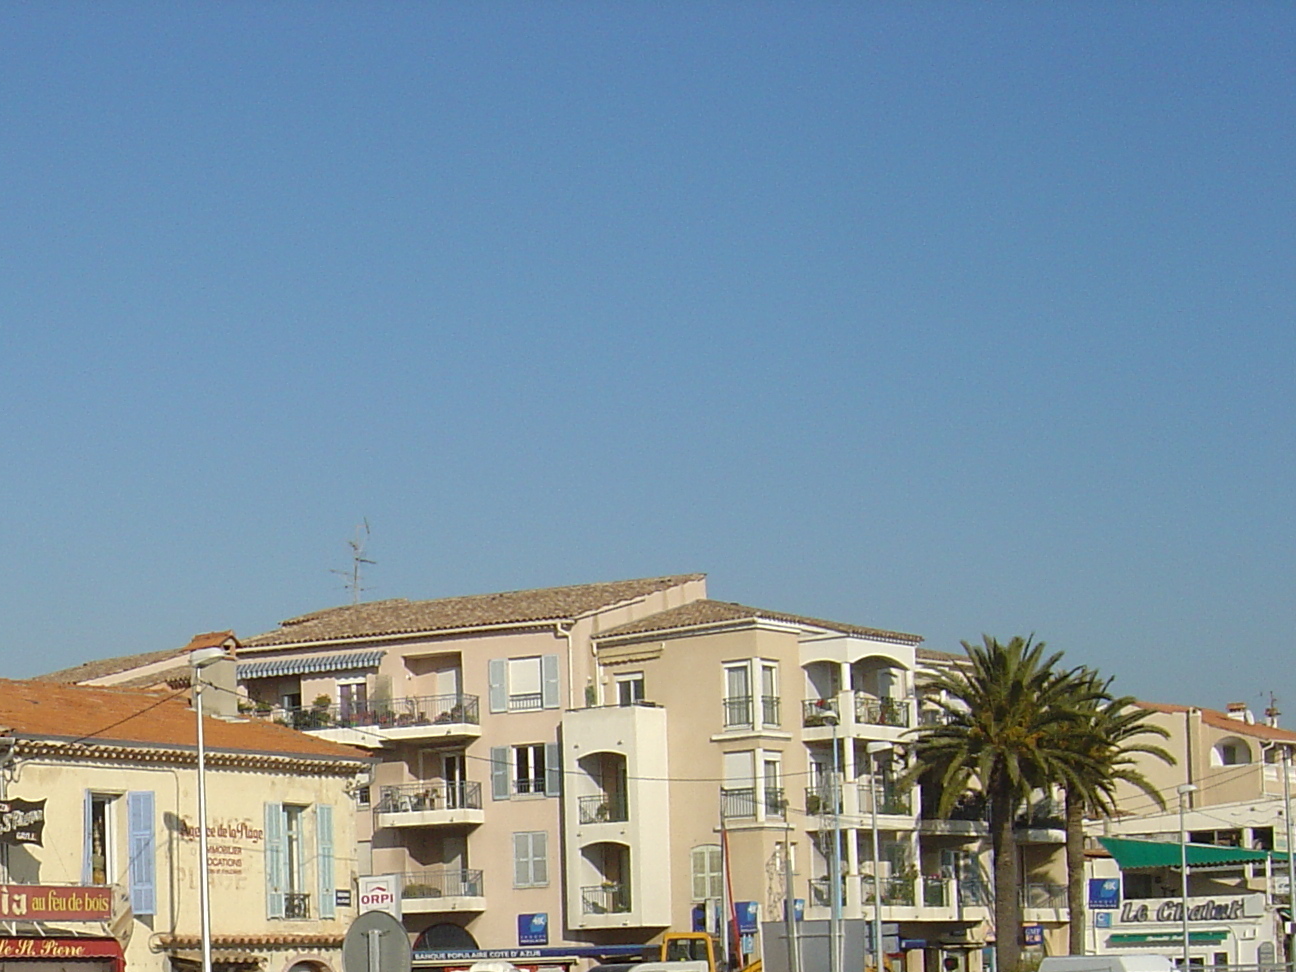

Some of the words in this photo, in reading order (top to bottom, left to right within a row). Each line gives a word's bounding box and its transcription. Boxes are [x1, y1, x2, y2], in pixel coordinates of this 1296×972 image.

[218, 824, 228, 838] de
[32, 896, 45, 911] au
[48, 889, 67, 912] feu
[68, 892, 84, 912] de
[85, 893, 109, 912] bois
[361, 893, 394, 905] ORPI
[1120, 901, 1149, 922] Le
[40, 940, 86, 956] Pierre
[415, 952, 445, 960] BANQUE
[447, 951, 487, 959] POPULAIRE
